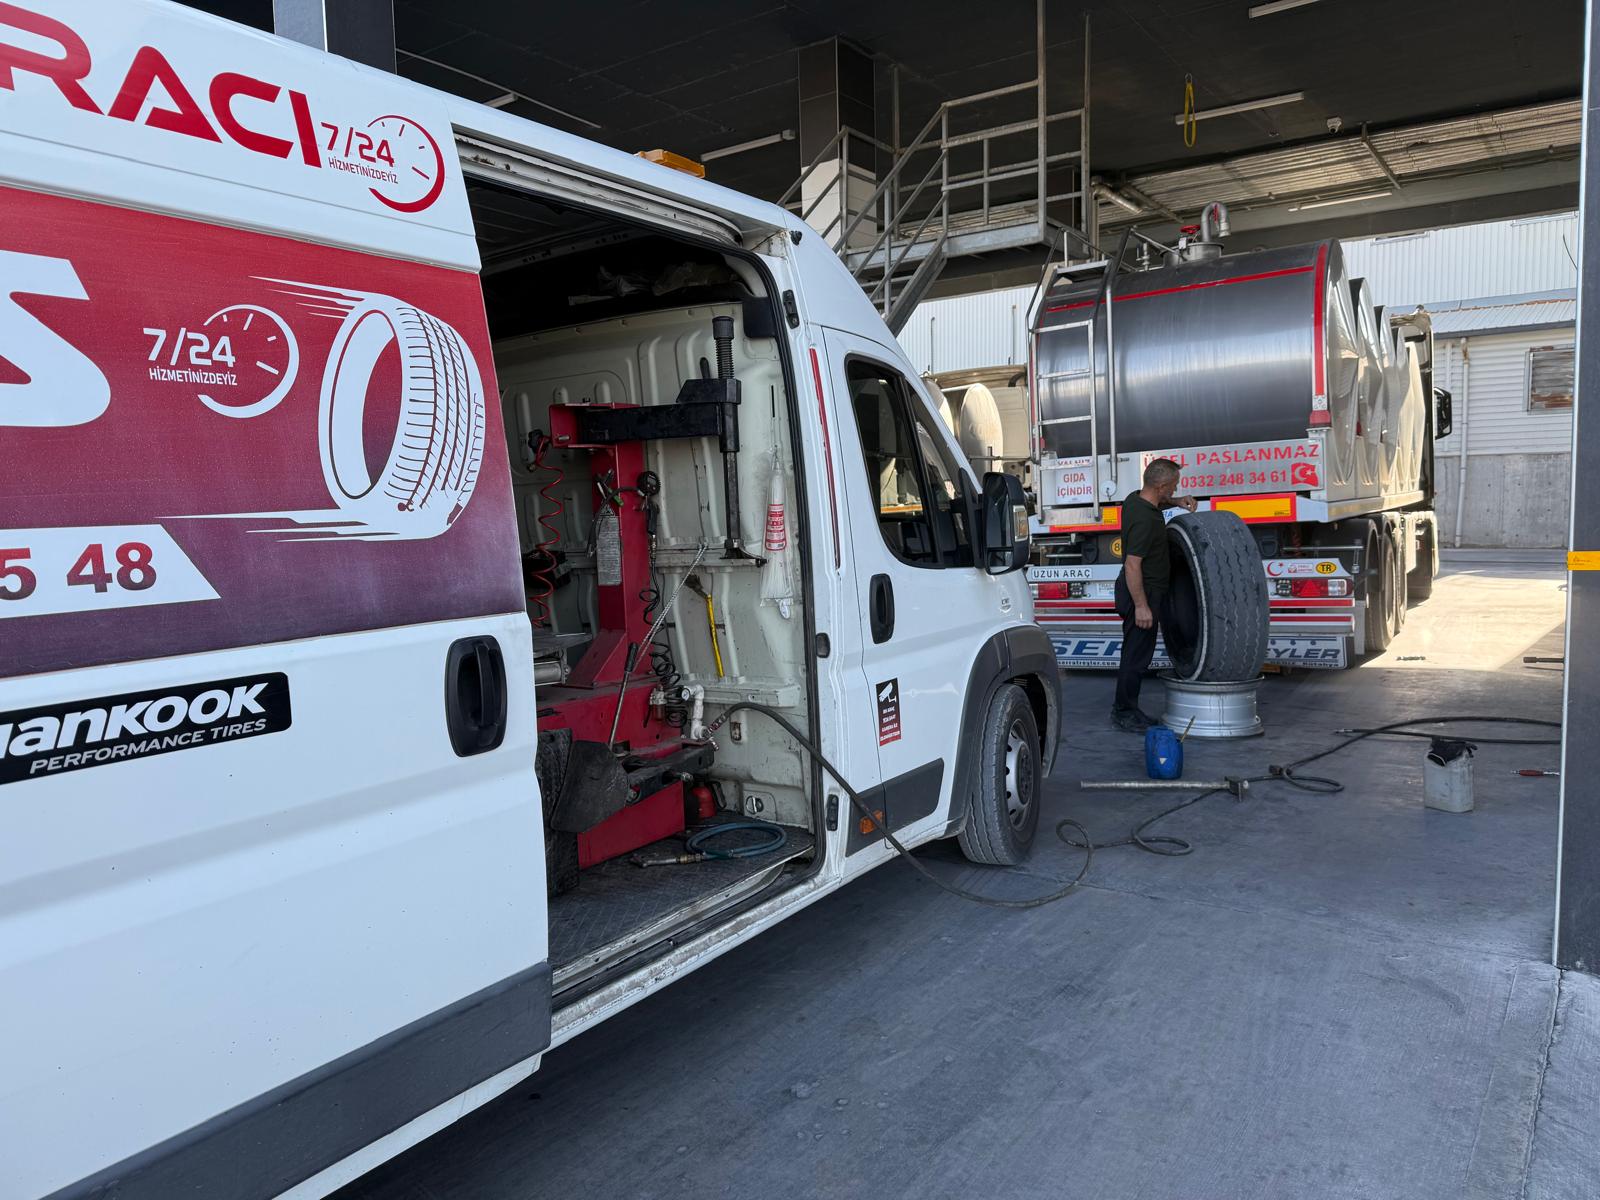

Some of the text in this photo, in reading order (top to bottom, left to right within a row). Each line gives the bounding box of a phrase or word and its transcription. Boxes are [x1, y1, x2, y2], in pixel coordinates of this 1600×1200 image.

[321, 121, 396, 168] 7/24
[328, 156, 399, 184] HİZMETİNİZDEYİZ
[143, 327, 236, 368] 7/24
[149, 366, 238, 387] HİZMETİNİZDEYİZ
[1196, 444, 1320, 466] PASLANMAZ
[1063, 473, 1086, 483] GIDA
[1181, 470, 1287, 488] 0332 248 34 61
[66, 542, 157, 594] 48
[1033, 569, 1091, 579] UZUN ARAÇ
[1264, 648, 1340, 659] YLER
[30, 718, 268, 775] PERFORMANCE TIRES
